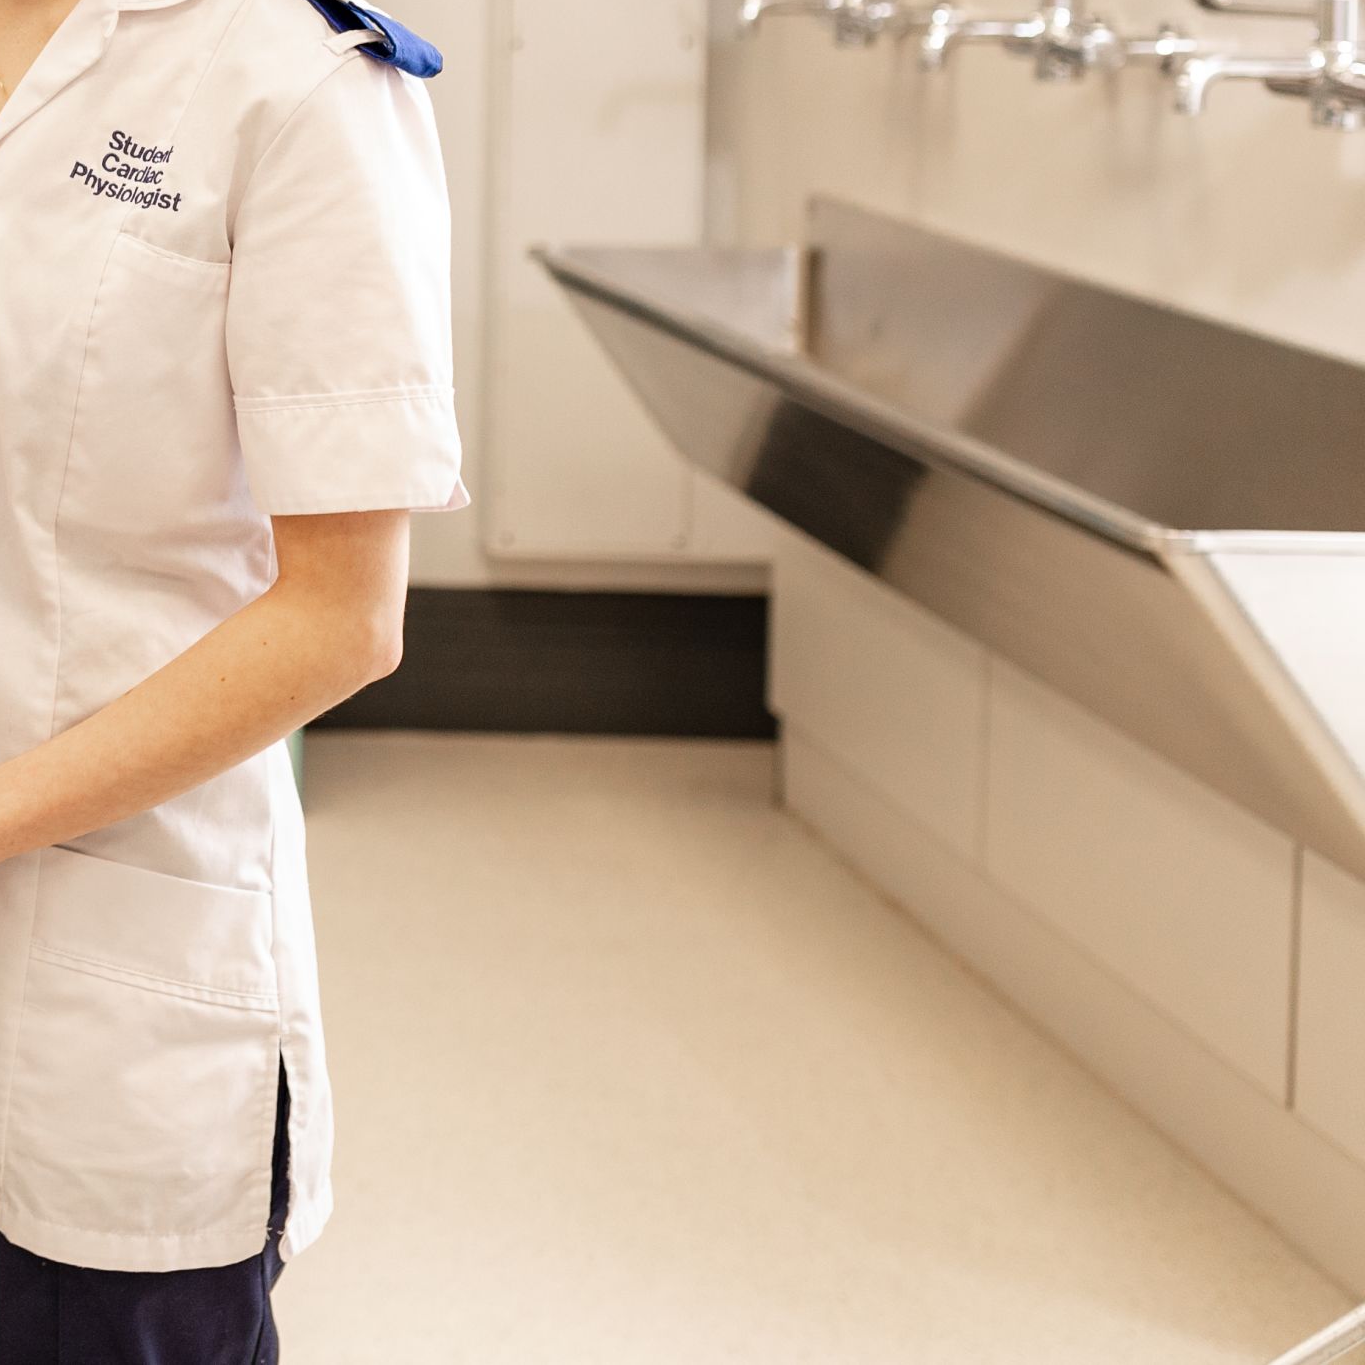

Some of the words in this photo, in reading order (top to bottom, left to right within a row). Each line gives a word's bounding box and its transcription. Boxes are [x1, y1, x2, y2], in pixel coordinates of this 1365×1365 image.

[109, 130, 174, 164] Student
[101, 152, 164, 185] Cardiac
[69, 161, 182, 212] Physiologist
